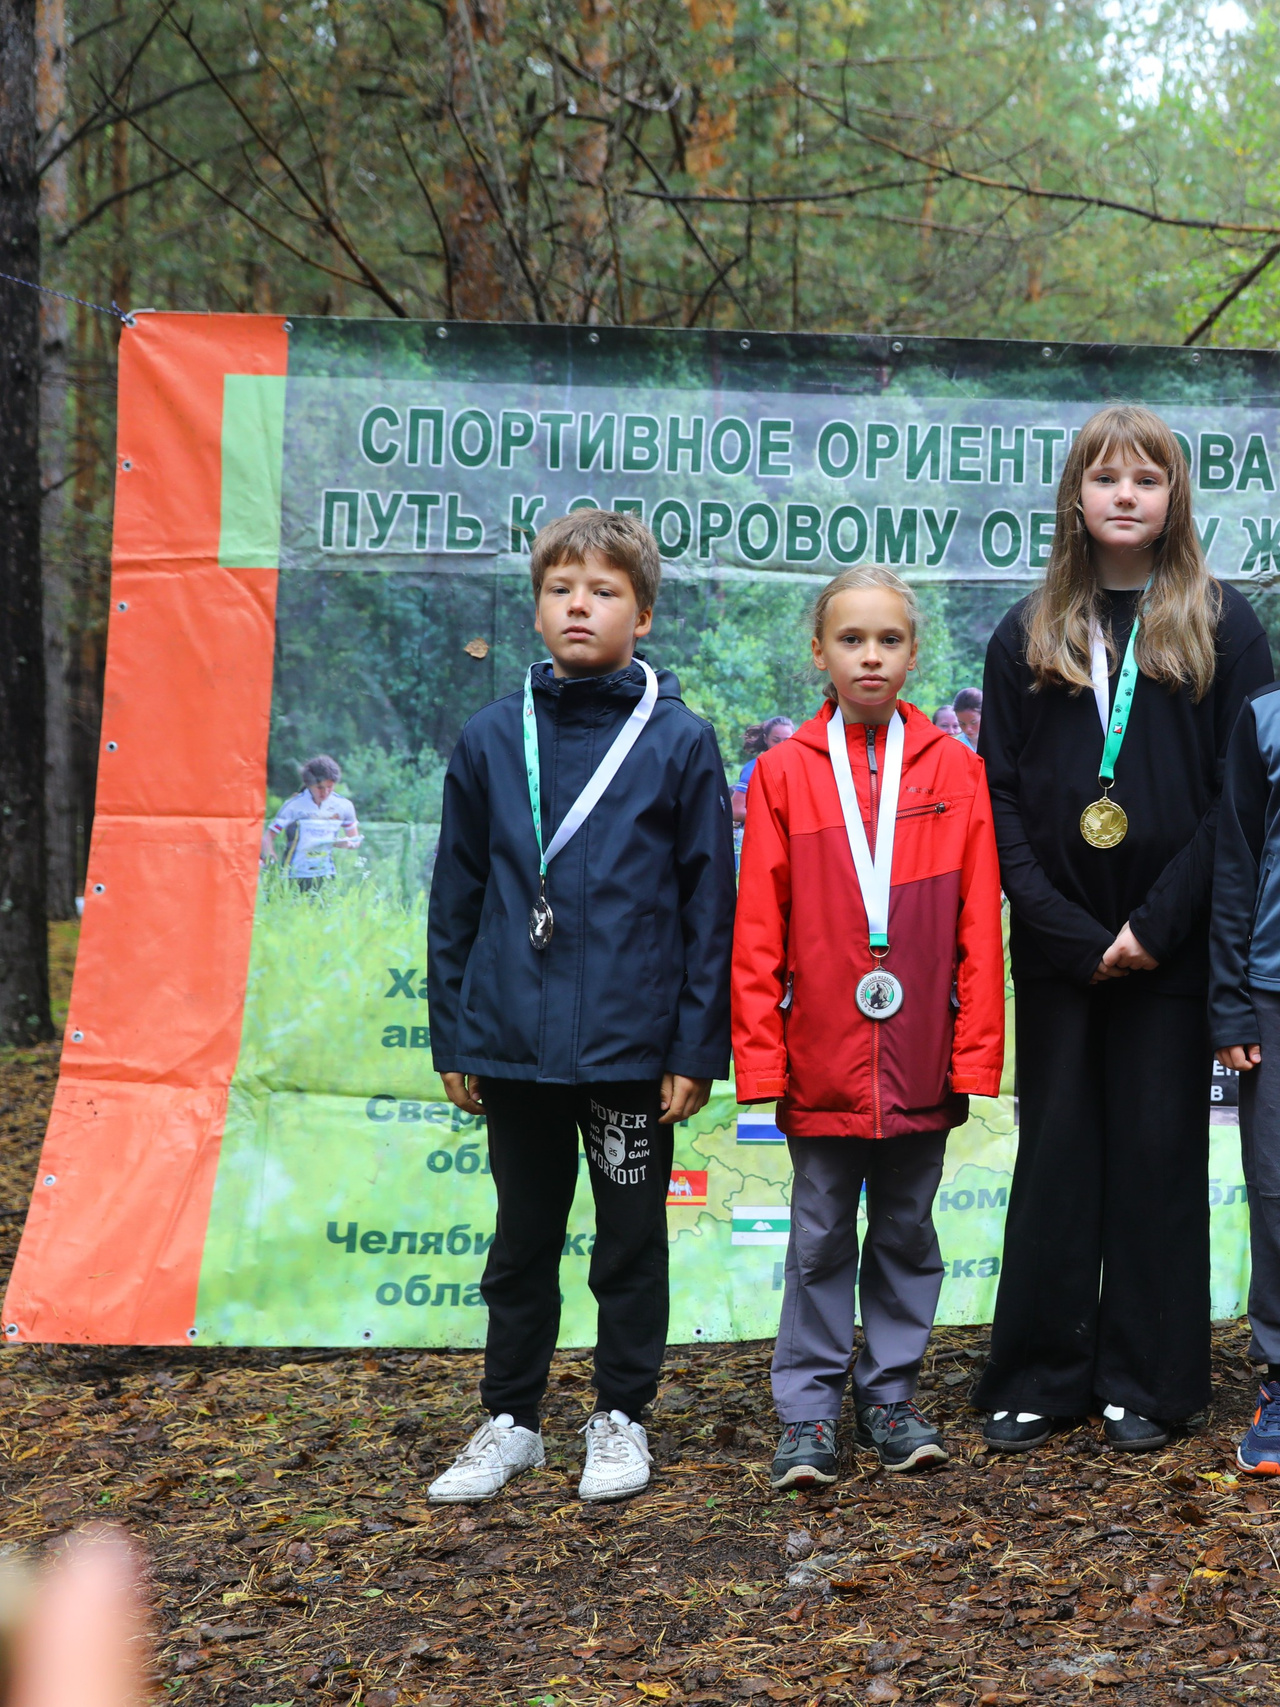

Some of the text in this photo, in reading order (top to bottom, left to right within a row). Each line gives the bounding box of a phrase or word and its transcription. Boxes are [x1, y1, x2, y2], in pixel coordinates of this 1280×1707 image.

[361, 405, 794, 477] СПОРТИВНОЕ
[321, 489, 486, 552] ПУТЬ
[510, 494, 548, 555] К
[566, 495, 959, 567] ОРОВОМУ
[590, 1099, 647, 1129] POWER
[628, 1148, 650, 1159] GAIN
[634, 1138, 648, 1148] NO
[590, 1145, 647, 1185] WORKOUT
